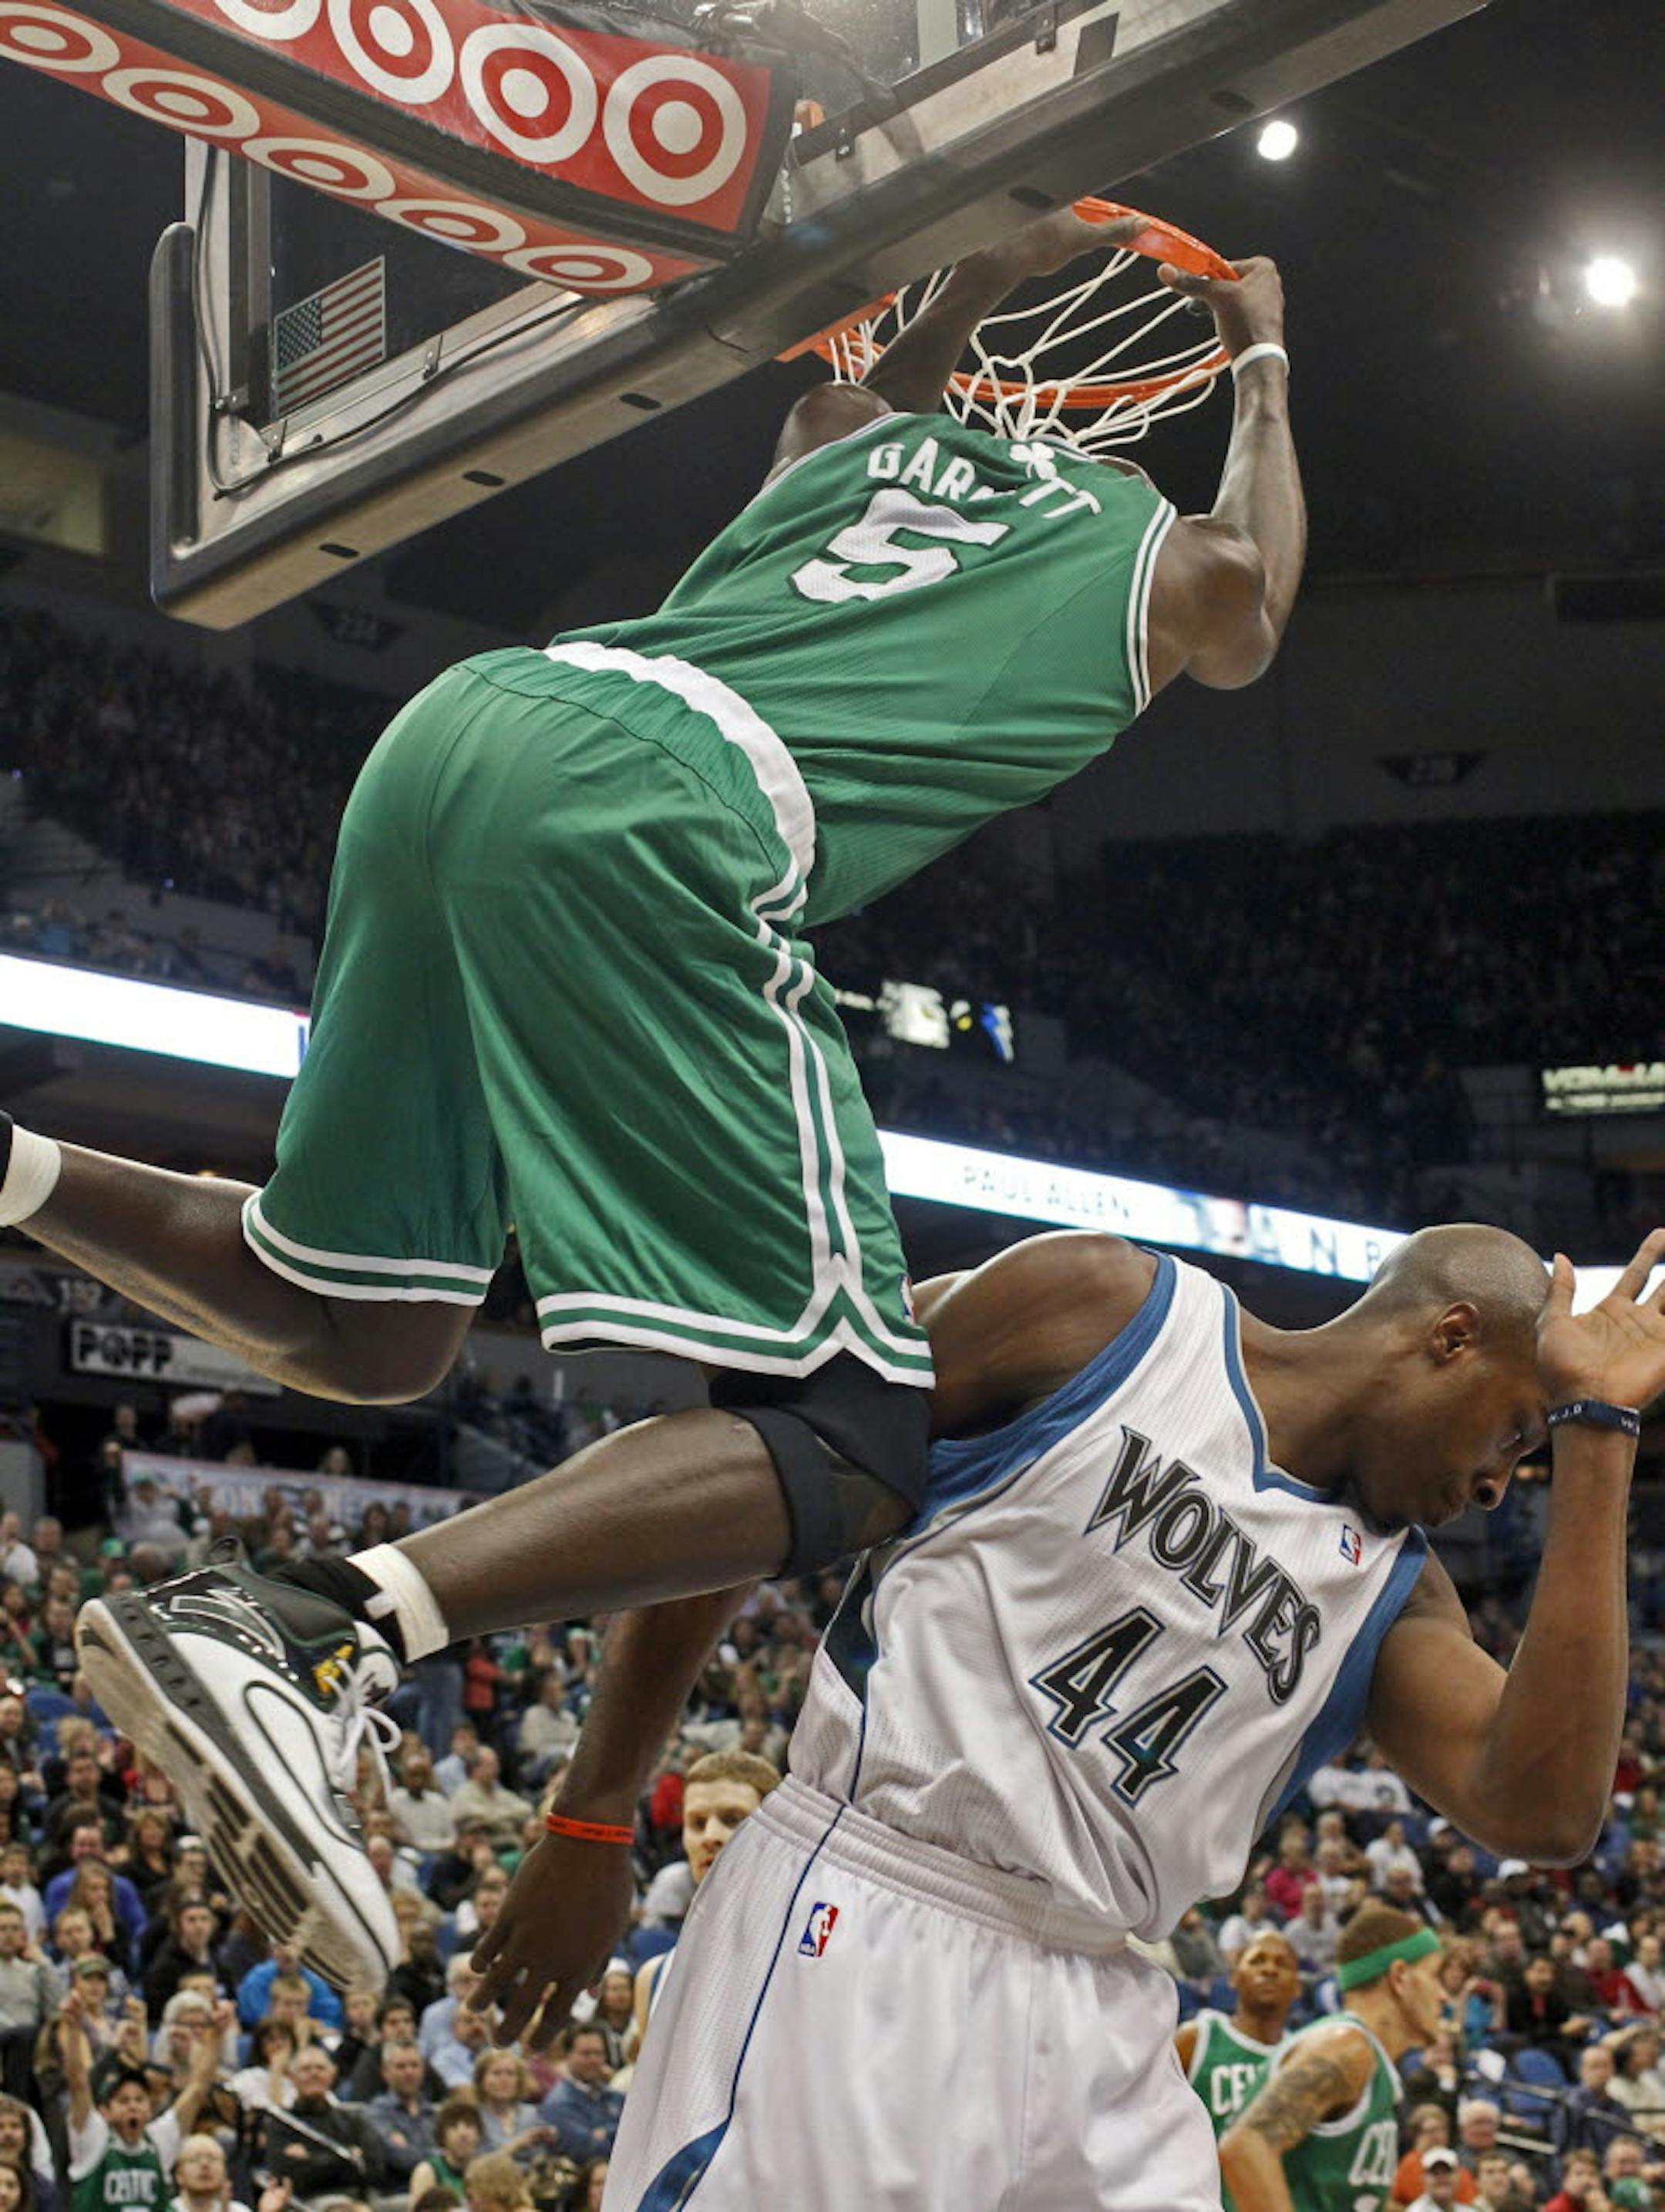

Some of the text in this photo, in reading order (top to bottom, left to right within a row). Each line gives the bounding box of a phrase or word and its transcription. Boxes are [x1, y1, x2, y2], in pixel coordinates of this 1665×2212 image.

[867, 437, 1103, 518] GARTT
[788, 487, 1011, 604] 5
[78, 1327, 173, 1372] POPP
[1082, 1423, 1322, 1706] WOLVES
[1028, 1605, 1229, 1810] 44
